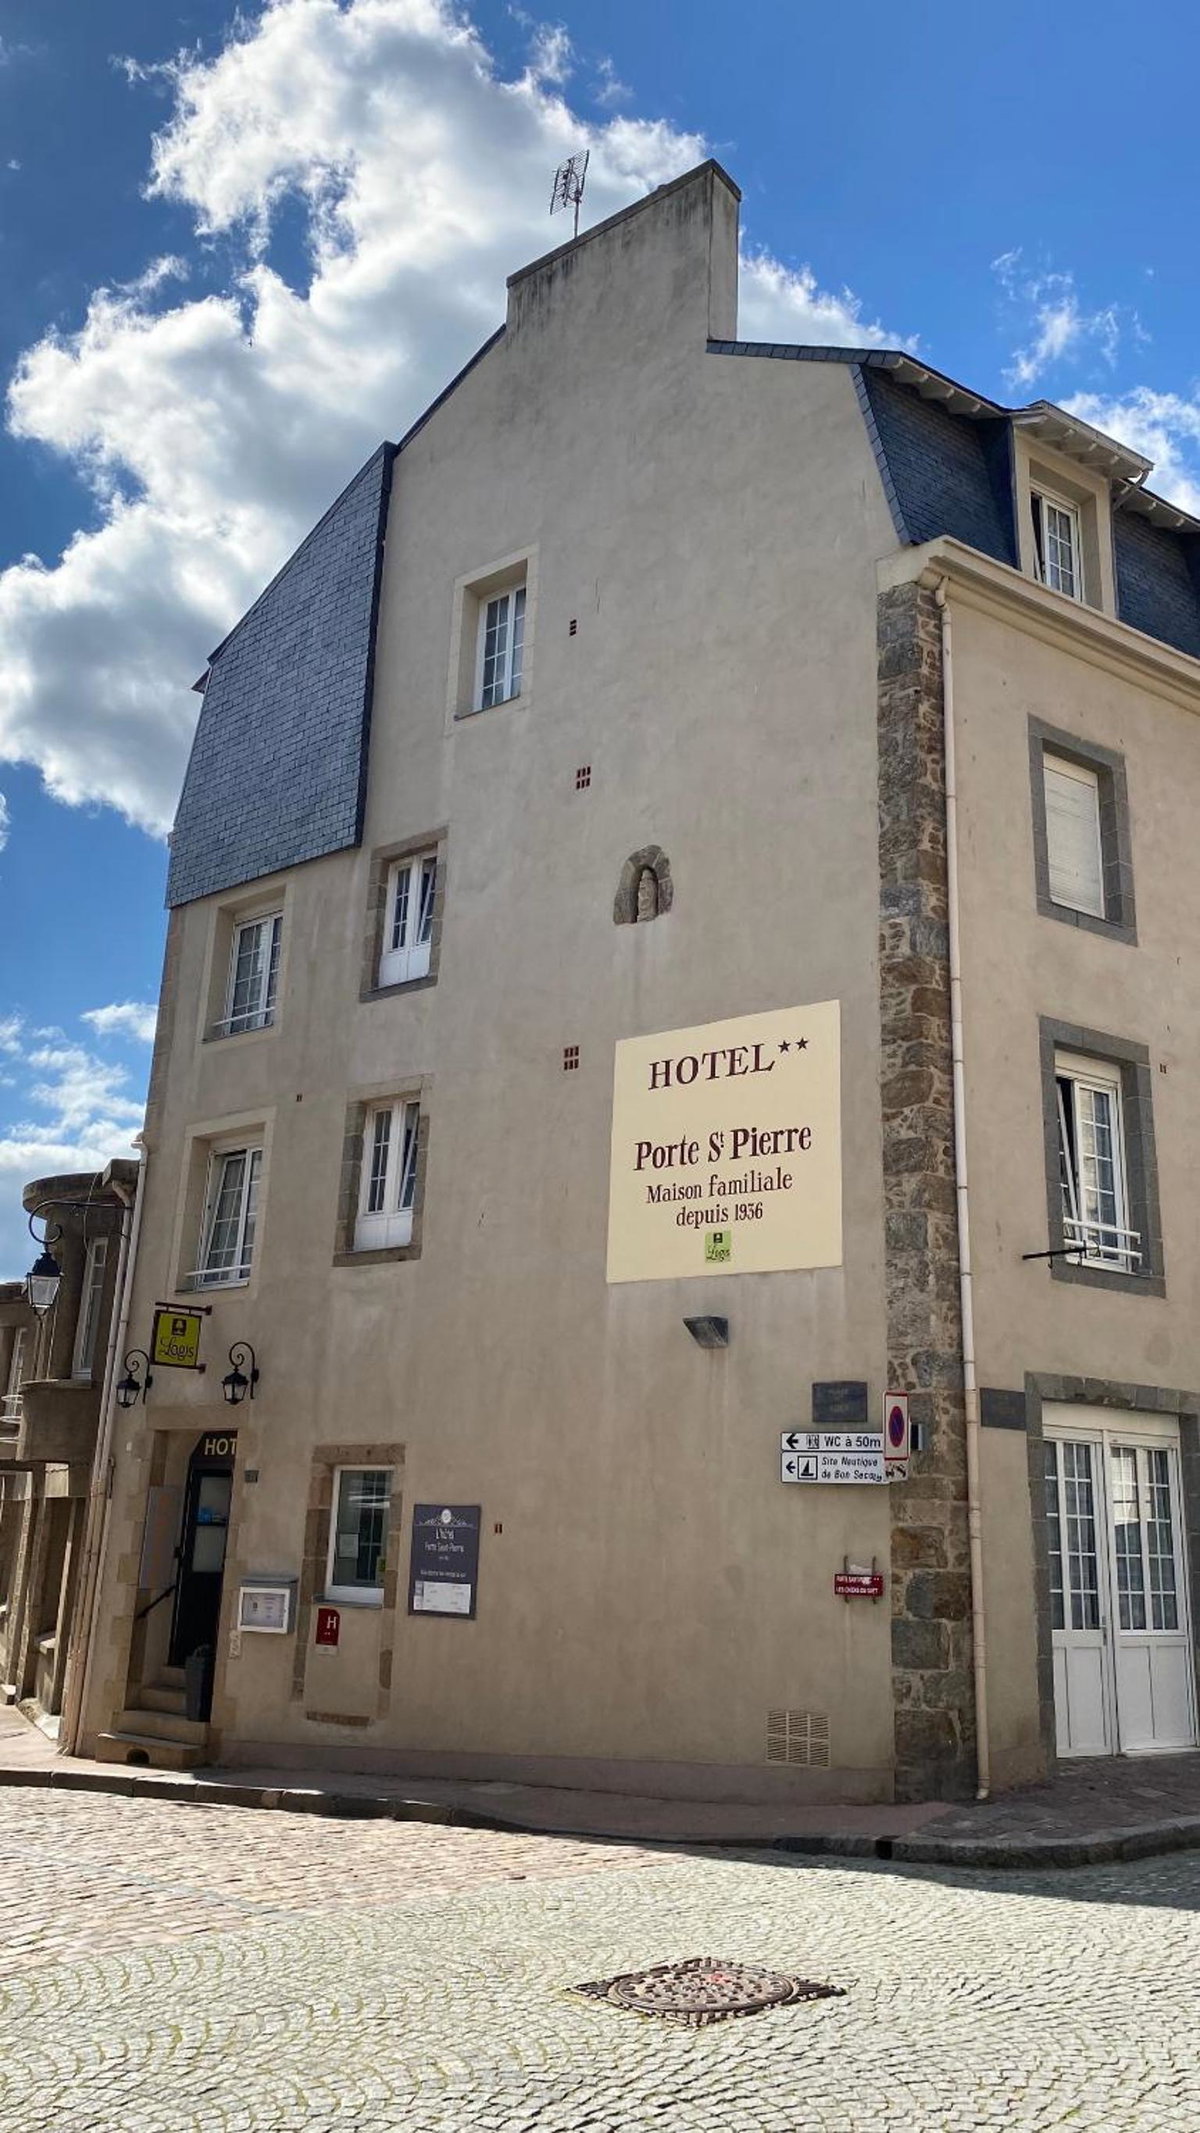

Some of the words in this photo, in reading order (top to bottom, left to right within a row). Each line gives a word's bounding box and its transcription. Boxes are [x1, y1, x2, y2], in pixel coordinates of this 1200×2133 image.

[648, 1043, 775, 1090] HOTEL
[633, 1135, 699, 1171] Porte
[730, 1126, 812, 1160] Pierre
[646, 1183, 702, 1204] Maison
[708, 1167, 793, 1197] familiale
[676, 1205, 729, 1229] depuis
[824, 1435, 841, 1447] WC
[845, 1435, 852, 1447] à
[855, 1435, 881, 1447] 50m
[821, 1456, 838, 1466] Site
[841, 1456, 878, 1467] Nautique
[821, 1469, 831, 1478] de
[834, 1469, 850, 1479] Bon
[326, 1616, 337, 1629] H
